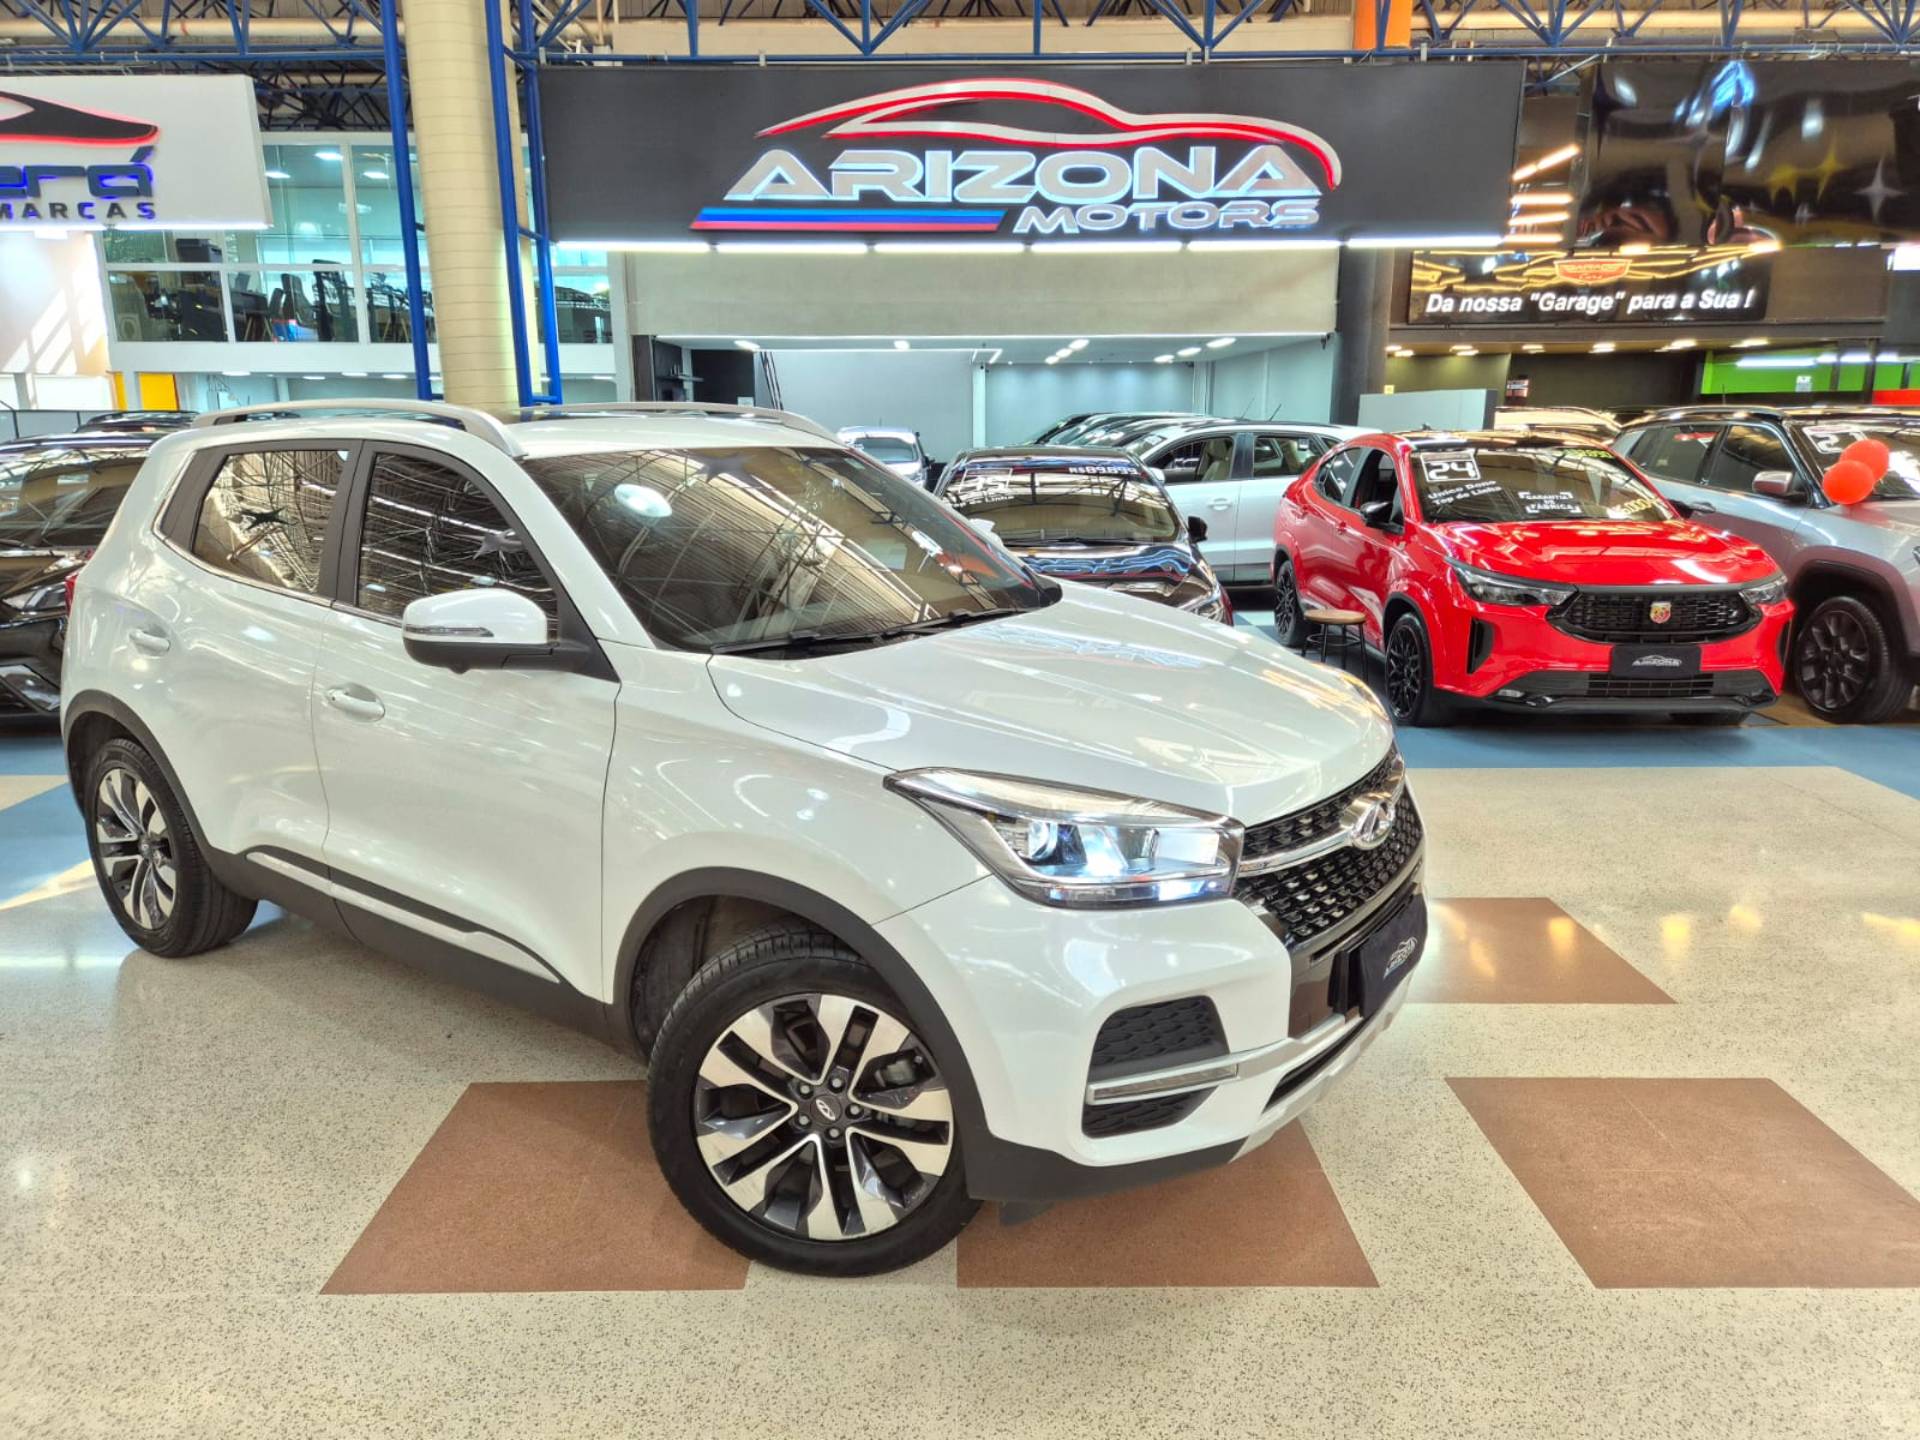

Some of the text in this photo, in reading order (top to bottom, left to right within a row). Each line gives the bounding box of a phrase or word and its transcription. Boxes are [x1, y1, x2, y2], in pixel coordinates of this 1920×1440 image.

[724, 145, 1322, 204] ARIZONA
[1014, 199, 1321, 234] MOTORS
[1425, 294, 1453, 313] Da
[1460, 296, 1522, 312] nossa
[1530, 292, 1625, 315] "Garage"
[1627, 294, 1675, 314] para
[1680, 296, 1693, 310] a
[1698, 290, 1744, 309] Sua
[1428, 461, 1477, 480] 24
